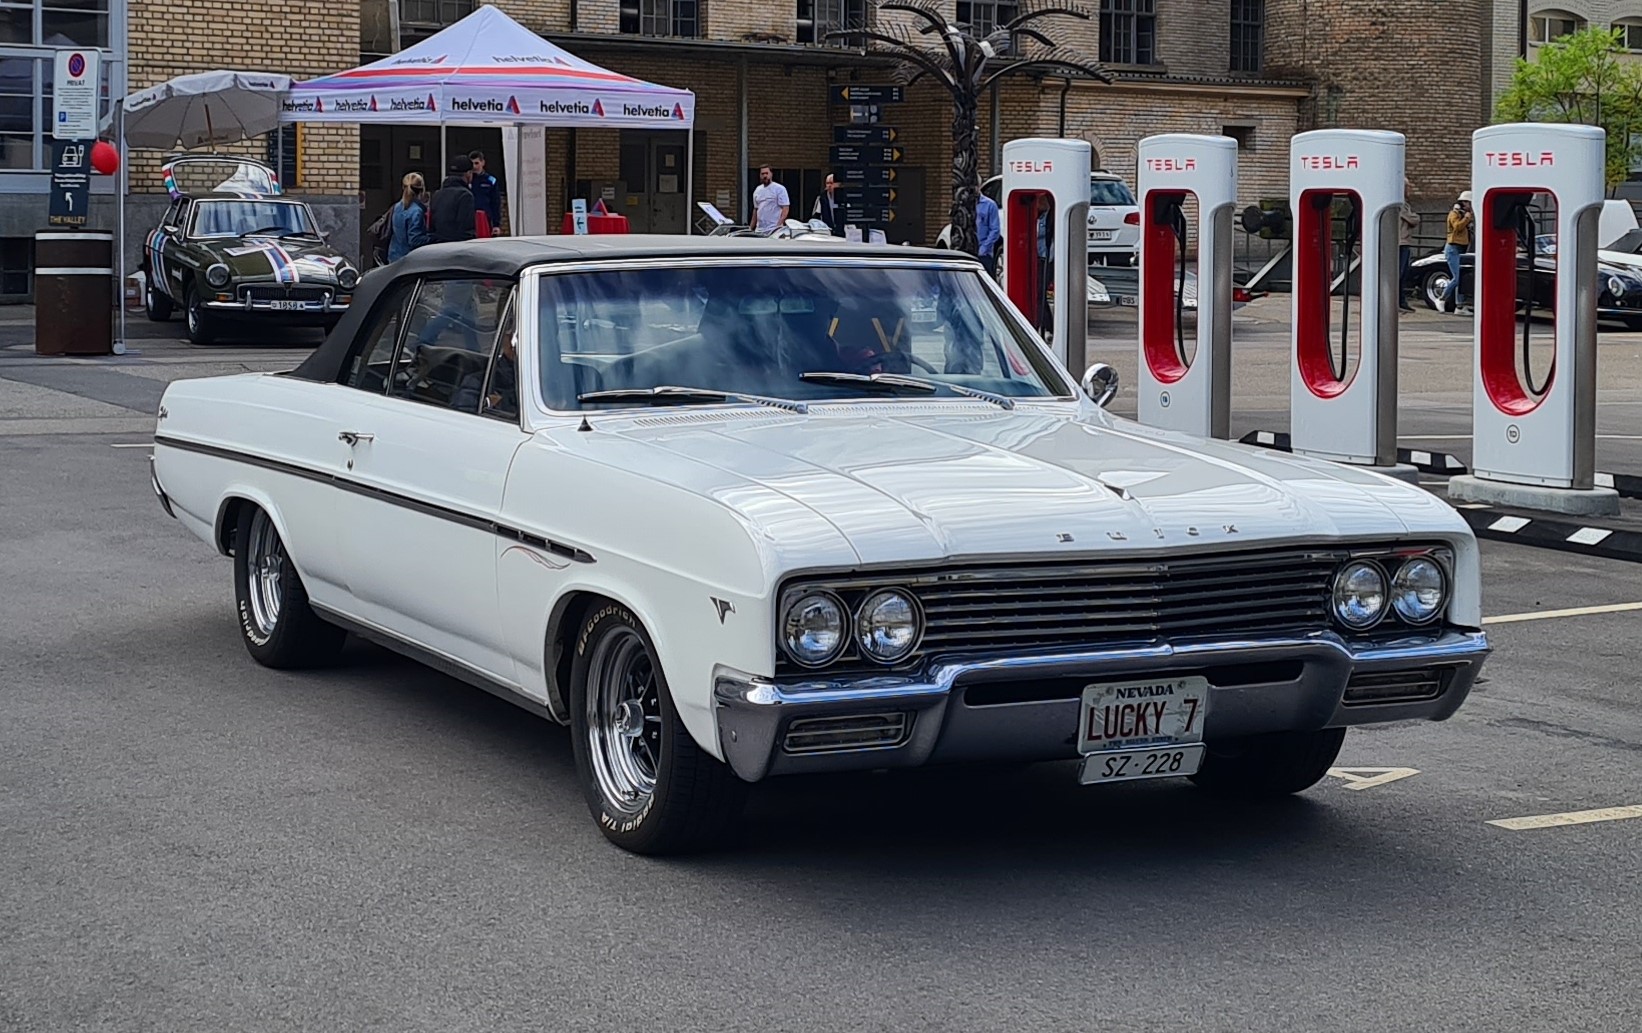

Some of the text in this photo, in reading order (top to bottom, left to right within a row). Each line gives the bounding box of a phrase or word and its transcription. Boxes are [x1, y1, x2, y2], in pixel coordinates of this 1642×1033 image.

[492, 55, 553, 65] helvetia
[282, 99, 314, 112] helvetia
[334, 98, 368, 112] helvetia
[390, 97, 425, 111] helvetia
[452, 97, 504, 112] helvetia
[540, 100, 589, 114] helvetia
[623, 103, 670, 117] helvetia
[1147, 159, 1195, 171] TESLA
[1301, 156, 1358, 169] TESLA
[1485, 152, 1553, 166] TESLA
[1009, 161, 1052, 173] TESLA
[1056, 523, 1239, 544] BUICK
[1115, 683, 1174, 699] NEVADA
[1087, 698, 1198, 741] LUCKY 7
